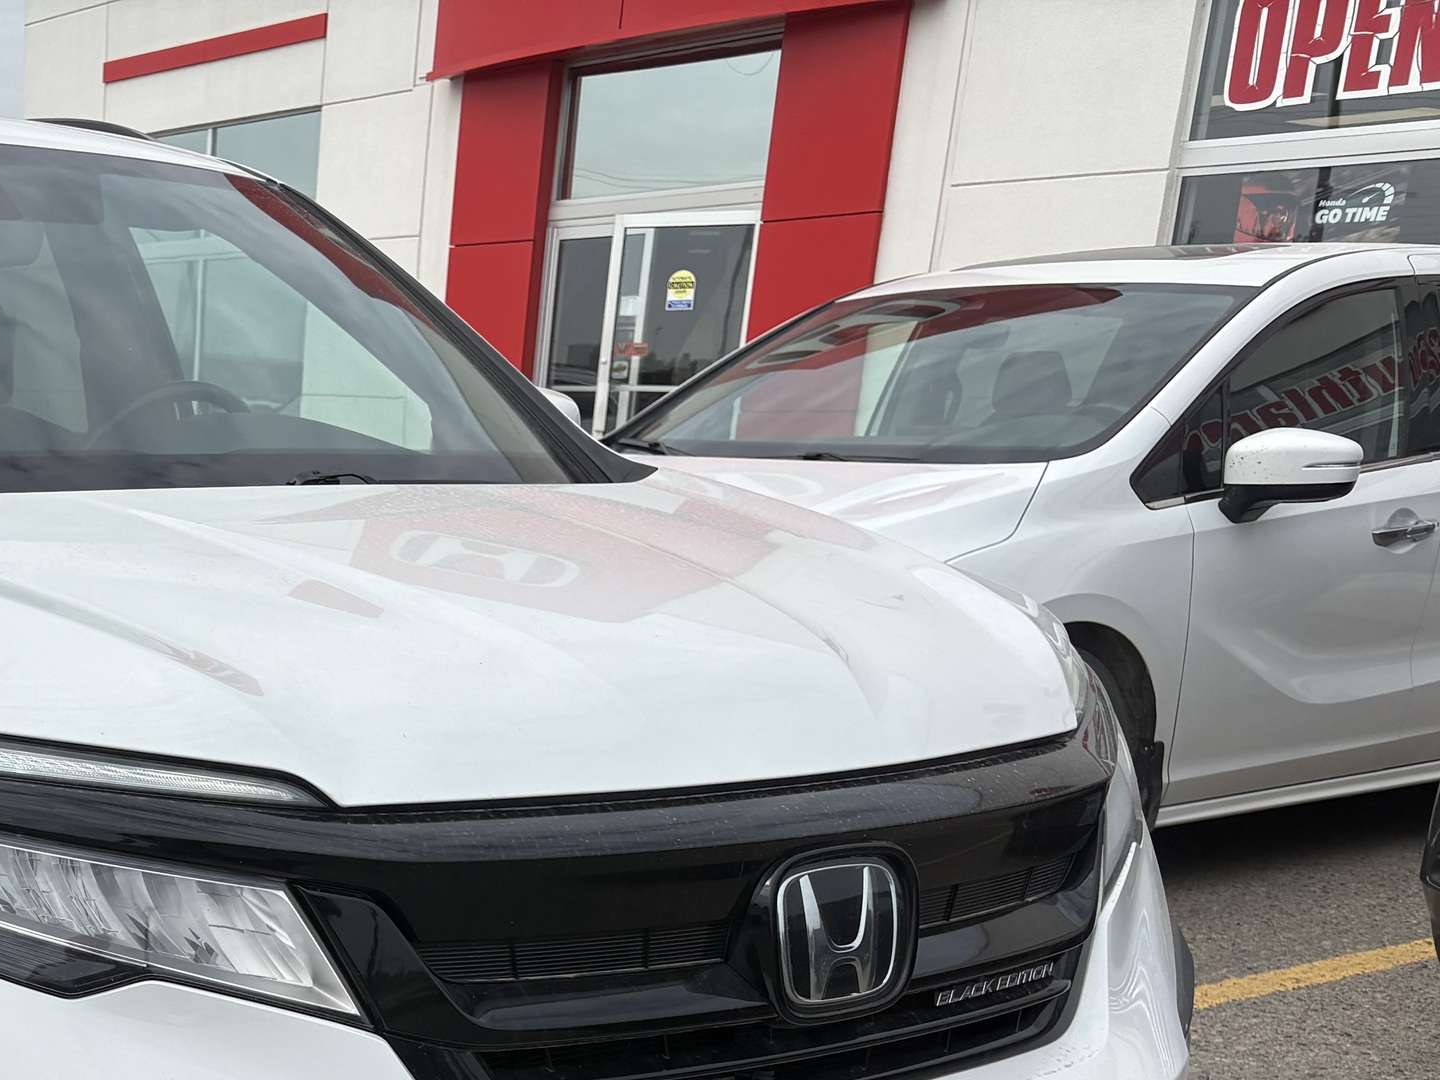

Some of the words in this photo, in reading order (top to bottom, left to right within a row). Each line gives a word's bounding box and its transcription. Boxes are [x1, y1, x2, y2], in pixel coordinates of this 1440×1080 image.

[1315, 208, 1343, 224] GO
[1344, 206, 1391, 223] TIME
[936, 979, 995, 1007] BLACK
[996, 961, 1055, 992] EDITION
